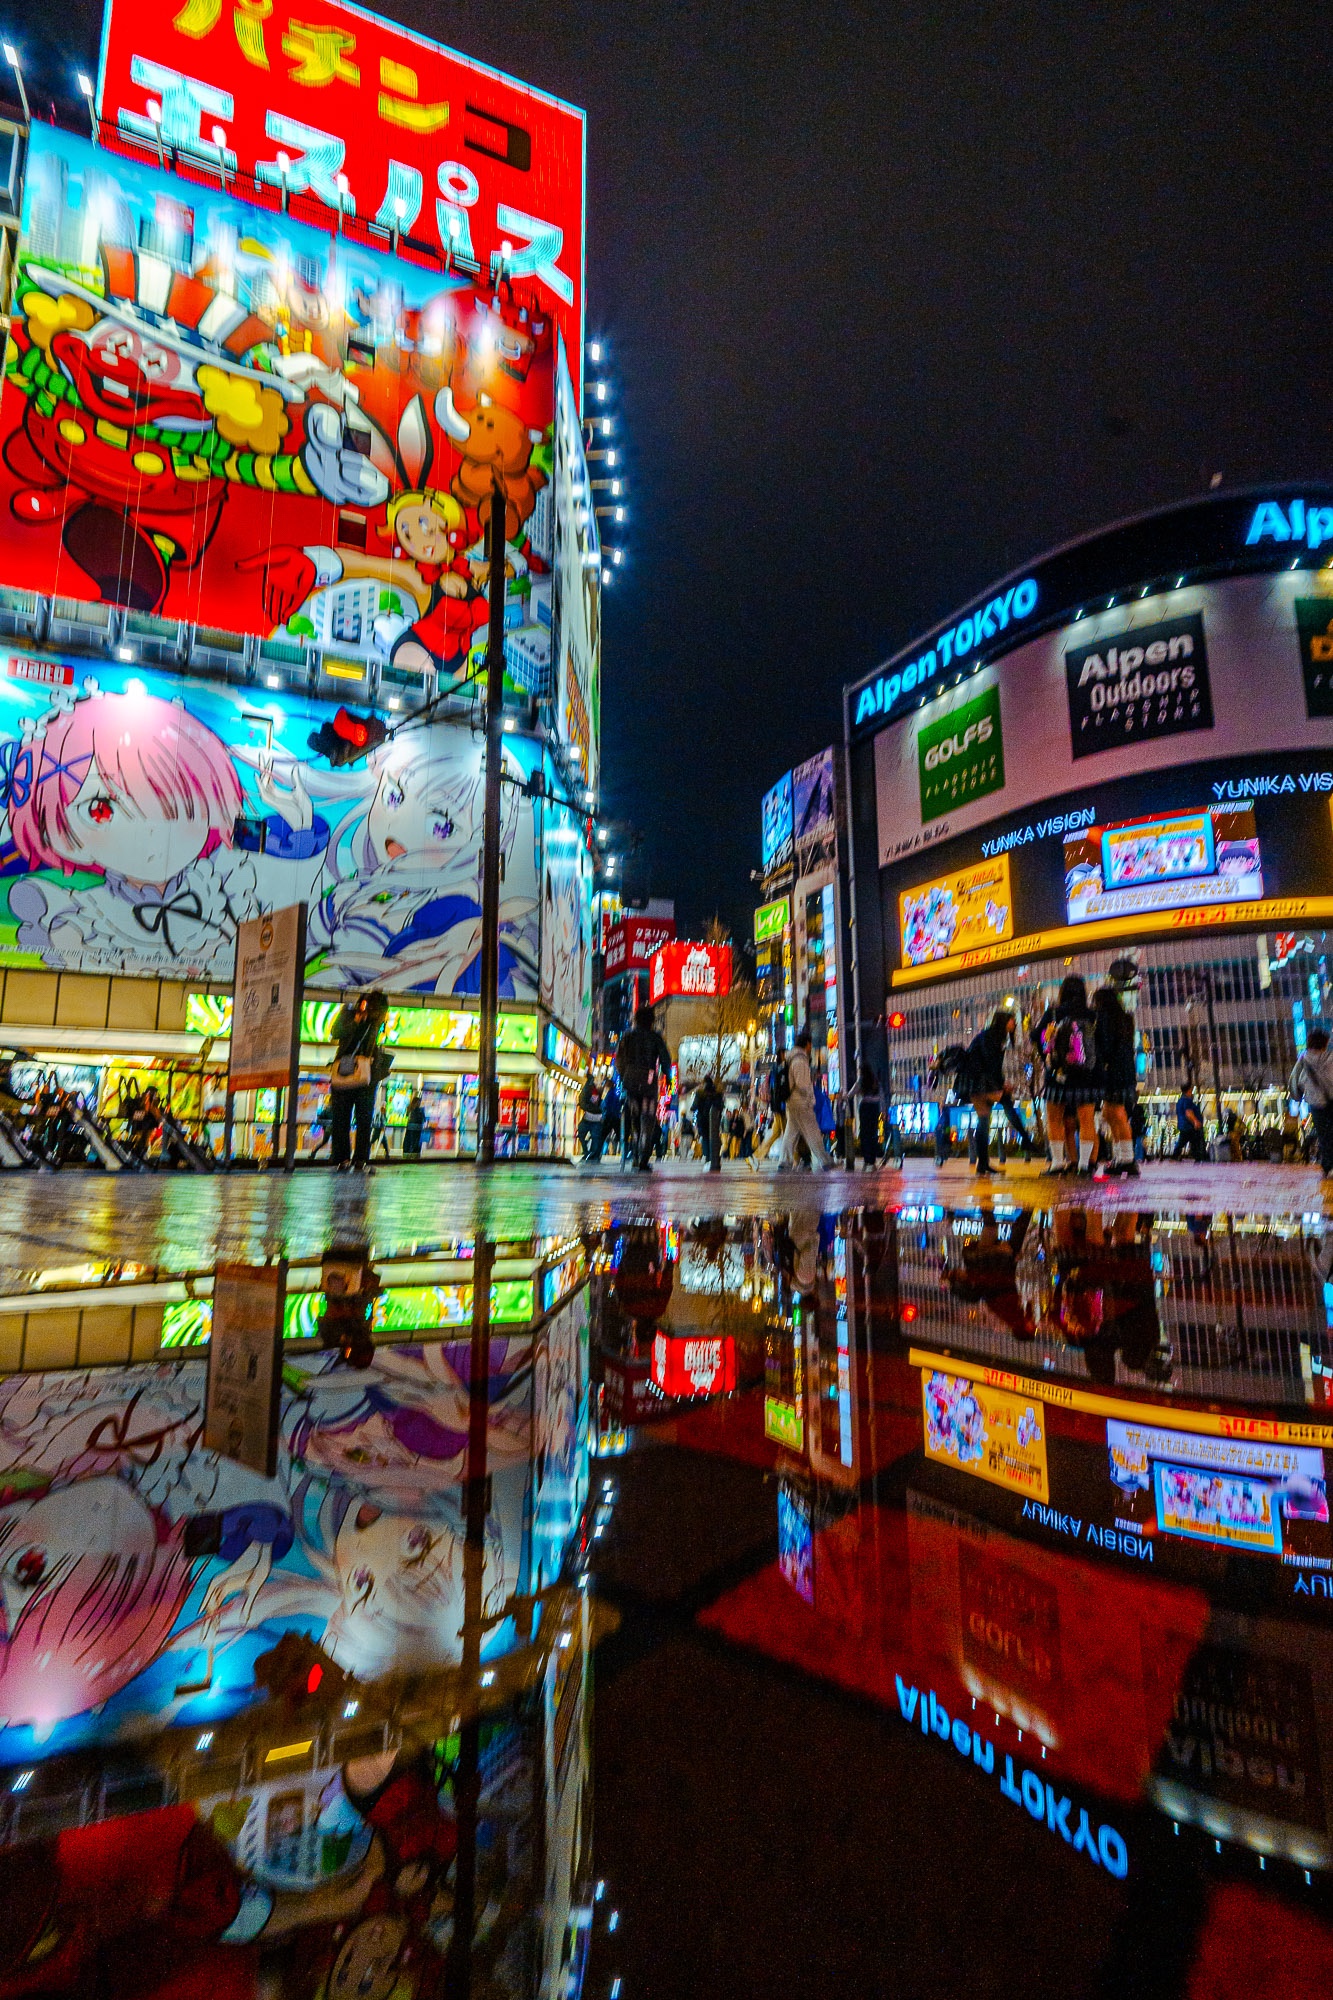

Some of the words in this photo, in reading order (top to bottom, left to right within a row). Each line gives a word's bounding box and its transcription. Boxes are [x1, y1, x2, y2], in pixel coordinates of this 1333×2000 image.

[118, 54, 573, 307] エスパス
[855, 650, 937, 725] Alpen
[936, 578, 1039, 668] TOKYO
[1077, 633, 1194, 688] Alpen
[1090, 665, 1196, 712] Outdoors
[924, 715, 994, 772] GOLF5
[1212, 774, 1296, 800] YUNIKA
[982, 828, 1035, 858] YUNIKA
[1036, 806, 1096, 839] VISION
[757, 903, 785, 932] レイク
